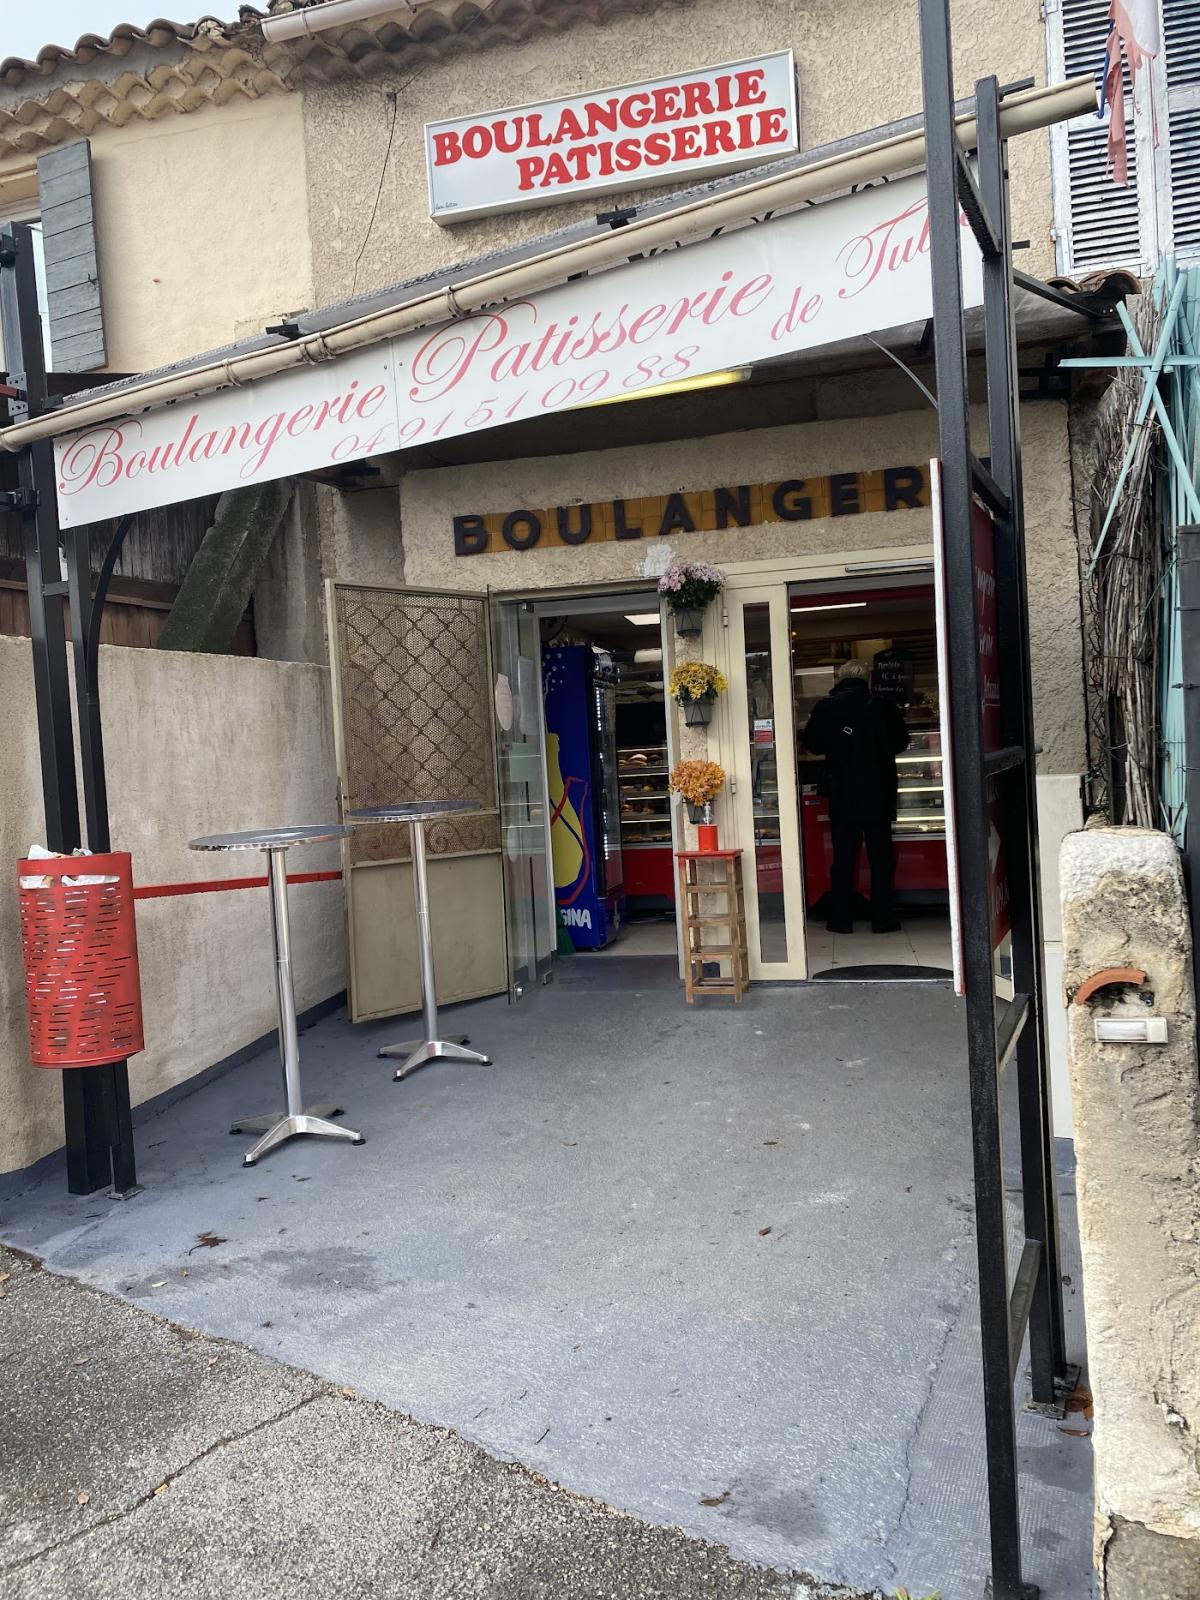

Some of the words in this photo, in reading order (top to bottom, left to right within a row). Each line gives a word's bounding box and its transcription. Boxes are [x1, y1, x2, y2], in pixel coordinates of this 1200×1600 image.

[433, 69, 766, 166] BOULANGERIE
[517, 107, 788, 190] PATISSERIE
[59, 379, 387, 495] Boulangerie
[409, 270, 774, 403] Patisserie
[771, 287, 823, 341] de
[330, 422, 395, 461] 04
[399, 409, 455, 448] 91
[464, 396, 524, 428] 51
[541, 369, 611, 408] 09
[622, 345, 701, 388] 88
[453, 465, 925, 556] BOULANGER
